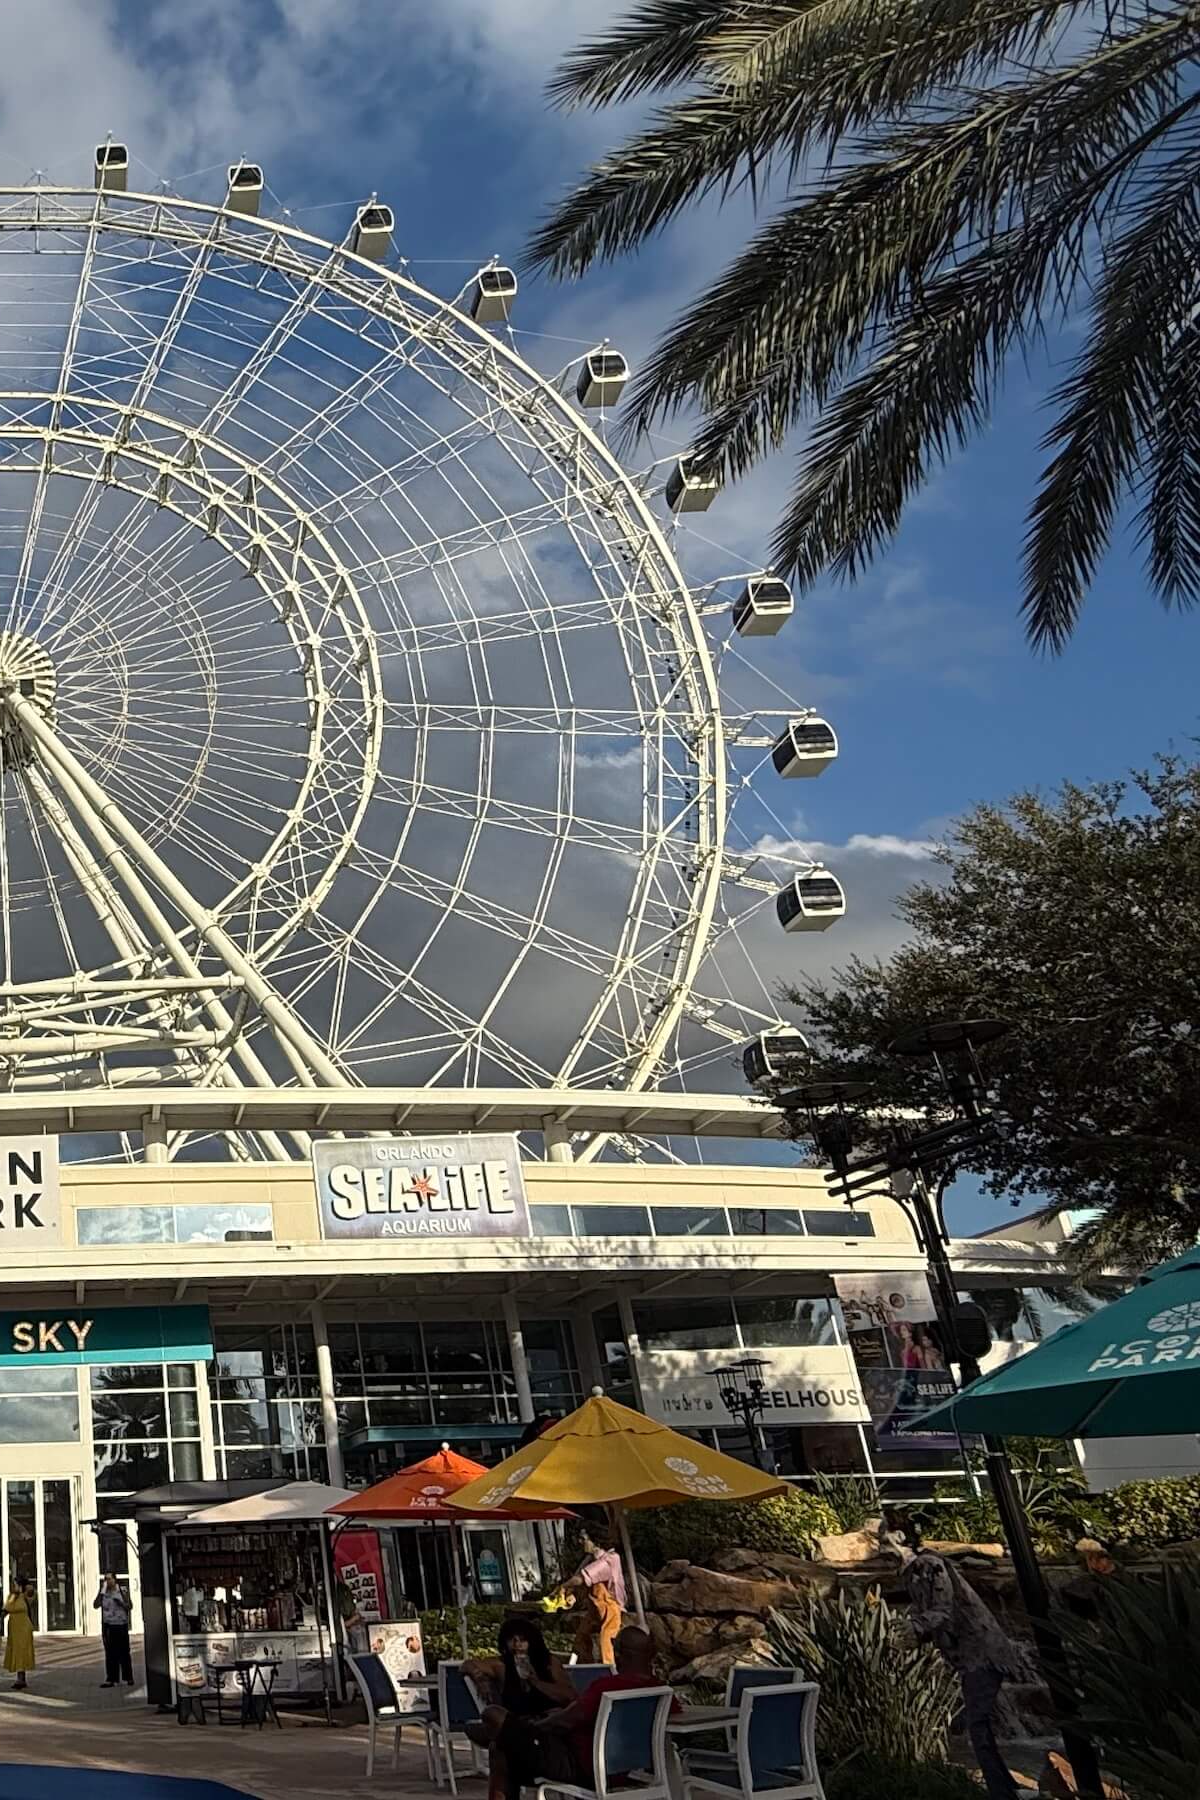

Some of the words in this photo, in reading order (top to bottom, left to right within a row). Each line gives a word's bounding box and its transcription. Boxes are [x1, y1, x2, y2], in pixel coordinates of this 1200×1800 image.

[376, 1144, 456, 1160] ORLANDO
[328, 1164, 423, 1220] SEA
[380, 1218, 473, 1235] AQUARIUM
[13, 1320, 94, 1353] SKY
[1100, 1335, 1200, 1358] ICO
[719, 1389, 861, 1409] WHEELHOUS
